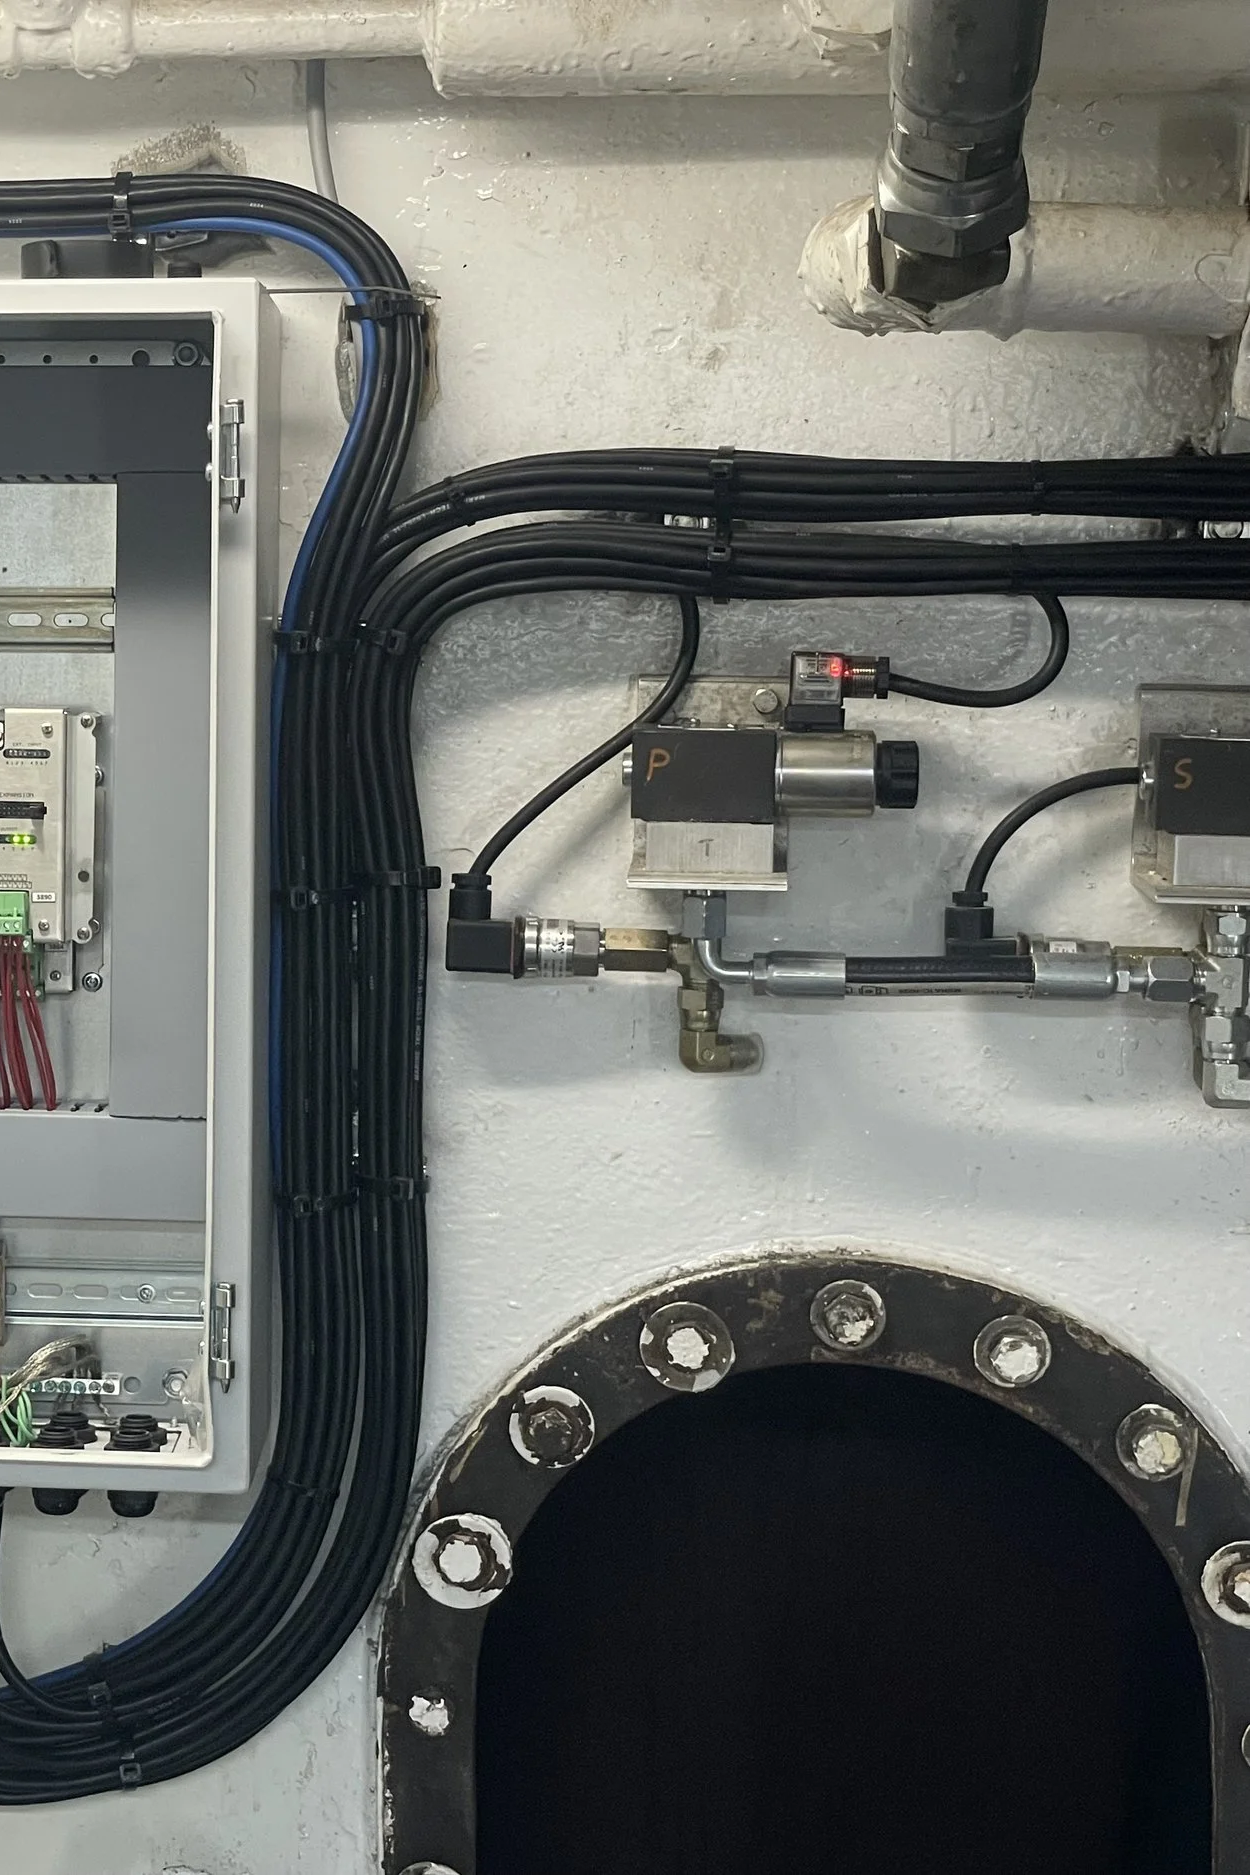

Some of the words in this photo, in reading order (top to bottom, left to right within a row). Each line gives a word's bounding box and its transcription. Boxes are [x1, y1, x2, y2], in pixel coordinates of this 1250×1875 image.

[646, 747, 671, 783] P
[1173, 757, 1194, 790] S
[698, 838, 715, 857] T
